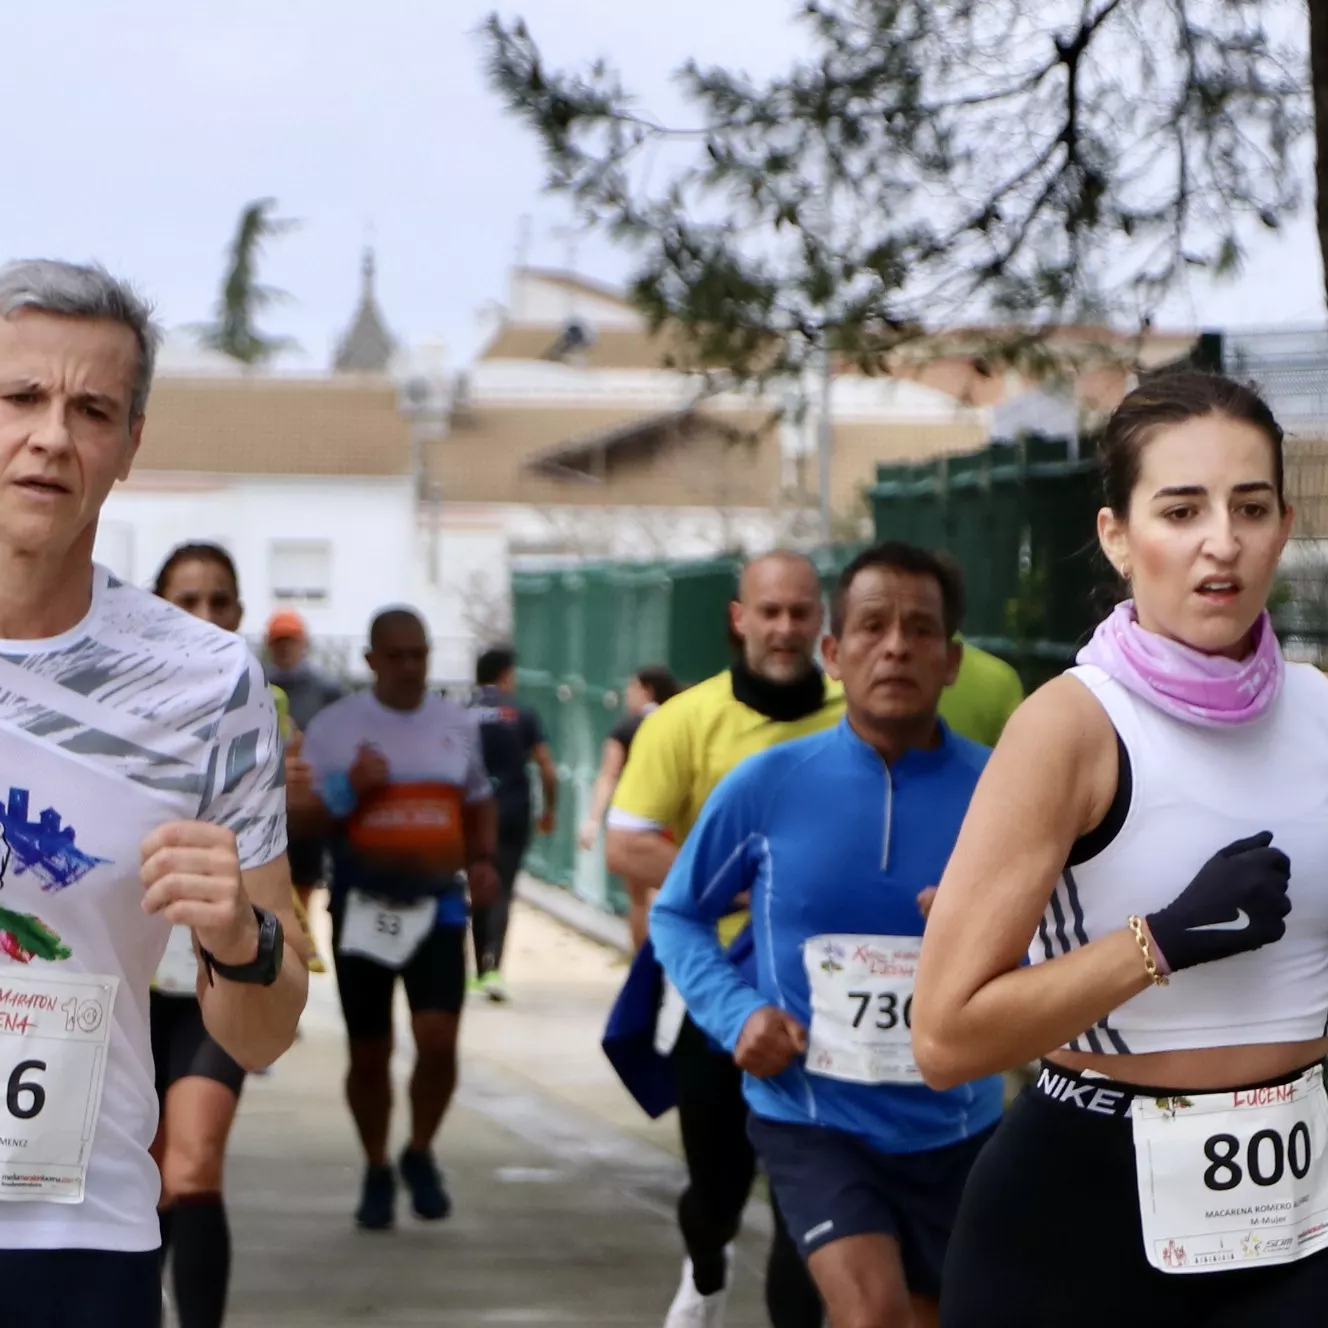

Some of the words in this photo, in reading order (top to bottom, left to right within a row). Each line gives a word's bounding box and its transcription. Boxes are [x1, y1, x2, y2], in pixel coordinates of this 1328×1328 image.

[1037, 1068, 1125, 1115] NIKE
[1233, 1084, 1298, 1107] LUCENA
[1203, 1121, 1311, 1191] 800
[1205, 1207, 1253, 1218] MACARENA
[1255, 1202, 1292, 1212] ROMERO
